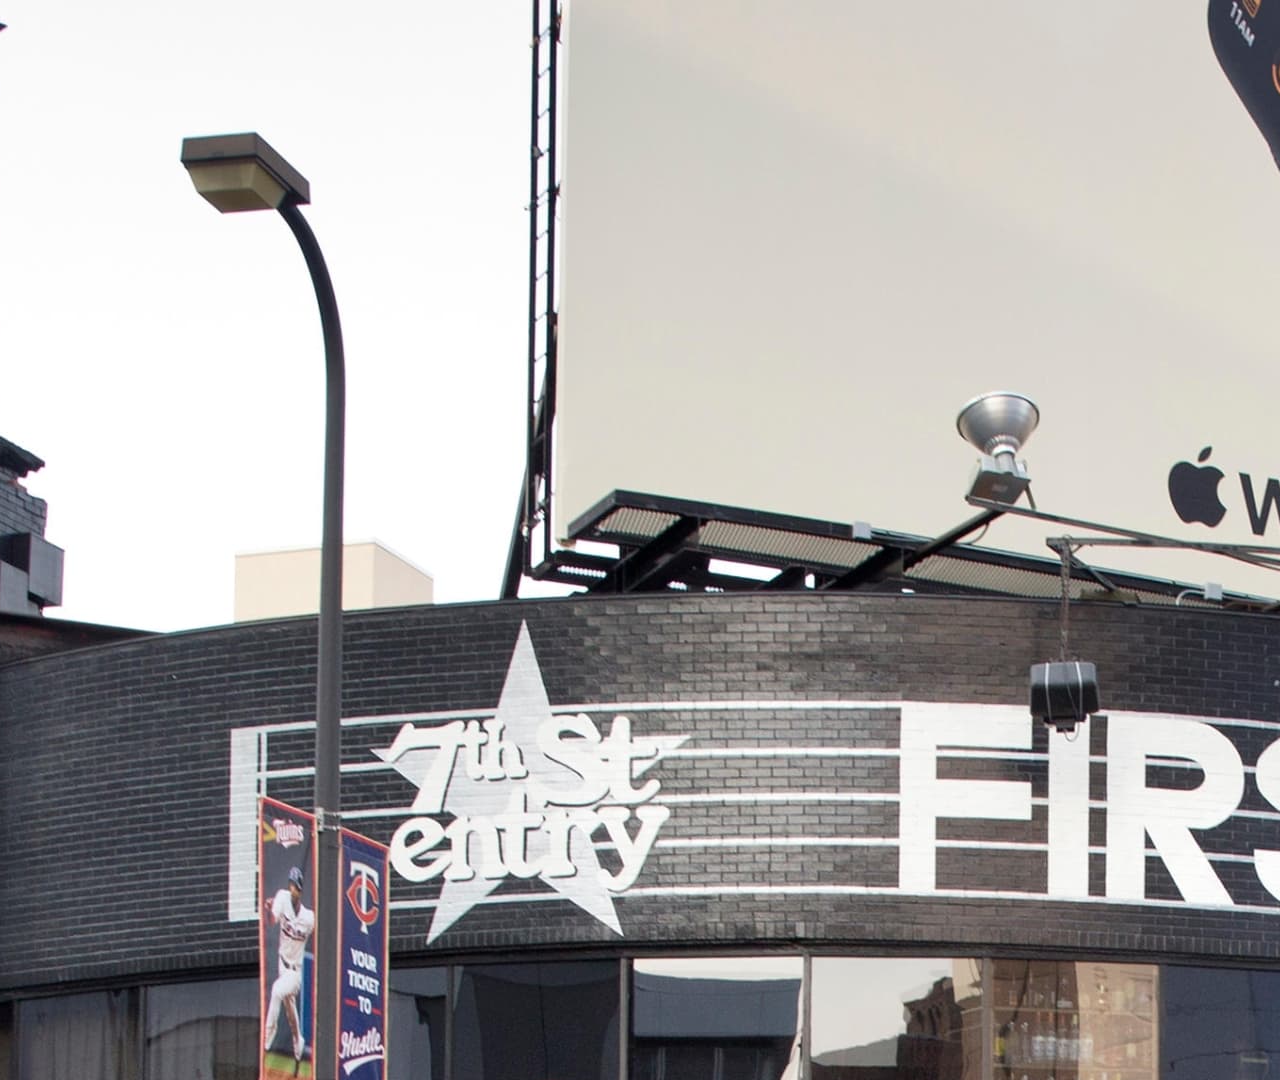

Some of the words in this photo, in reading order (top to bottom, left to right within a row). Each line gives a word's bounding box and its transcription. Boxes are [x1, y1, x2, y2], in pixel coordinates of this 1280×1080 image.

[1229, 2, 1256, 47] 11AM
[382, 720, 529, 814] 7th
[536, 713, 661, 807] St
[272, 818, 304, 844] Twins
[390, 786, 670, 892] entry
[351, 948, 378, 973] YOUR
[347, 969, 380, 998] TICKET
[358, 994, 372, 1015] TO
[340, 1026, 384, 1060] Hustle
